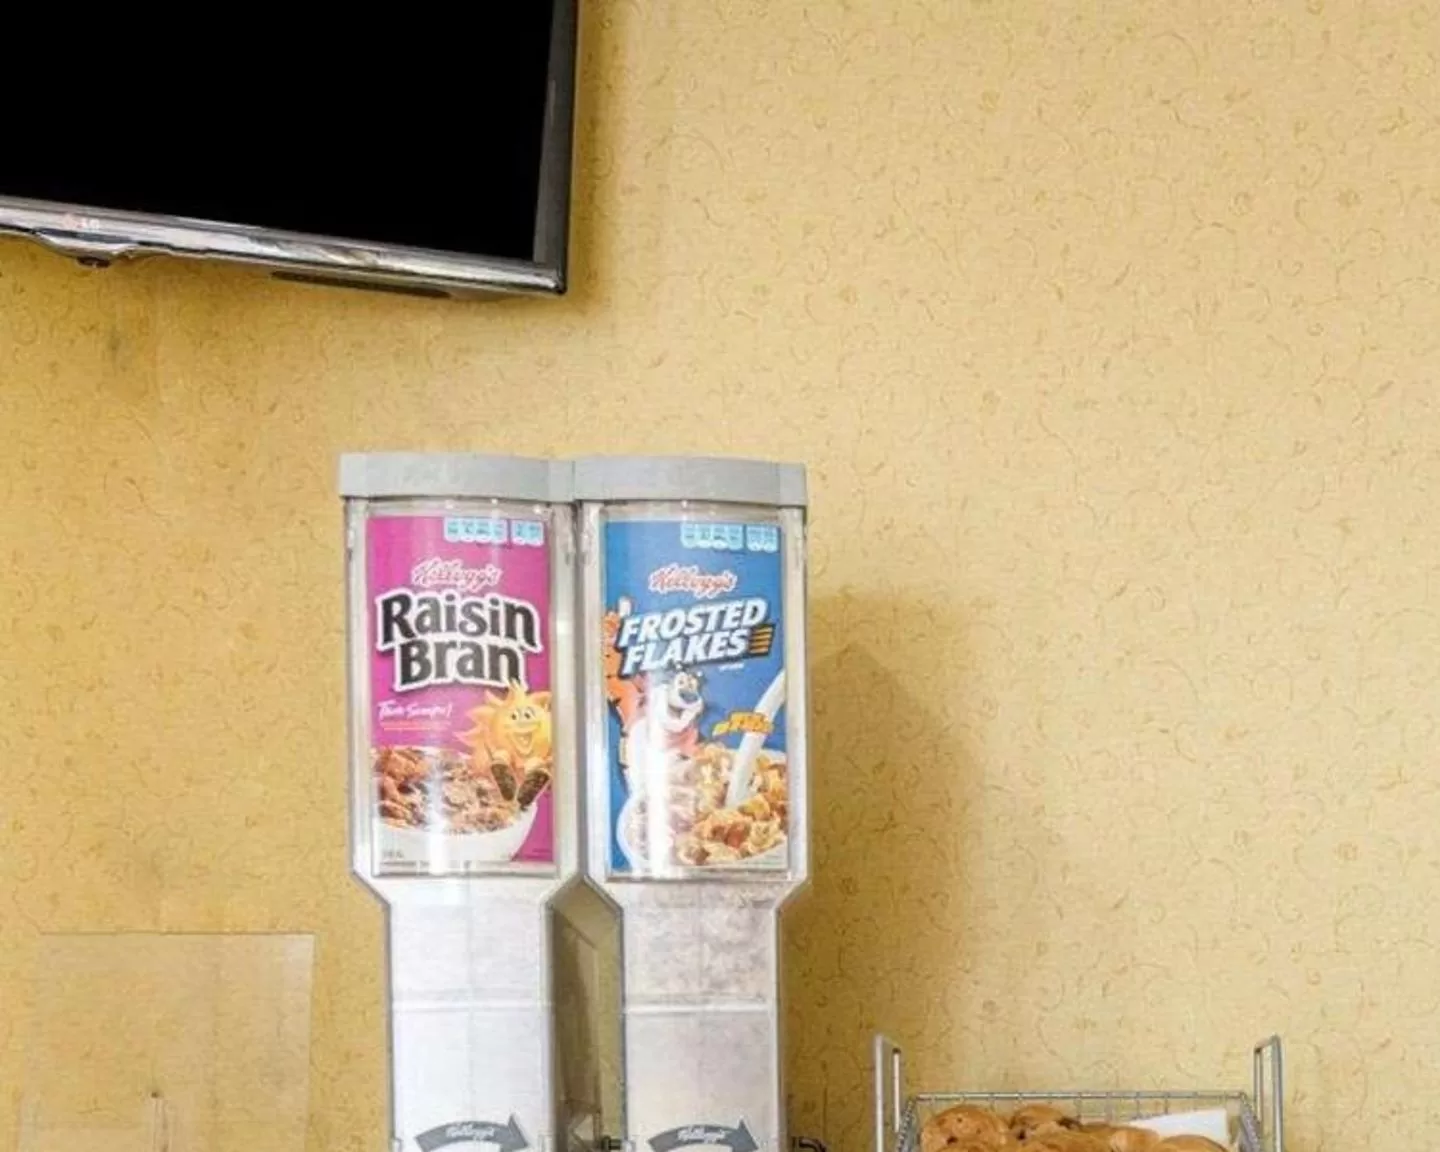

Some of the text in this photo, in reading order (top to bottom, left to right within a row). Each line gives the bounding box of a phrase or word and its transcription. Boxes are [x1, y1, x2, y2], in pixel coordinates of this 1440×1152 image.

[379, 591, 540, 650] Raisin
[617, 597, 769, 649] FROSTED
[398, 638, 524, 688] Bran
[621, 628, 750, 677] FLAKES
